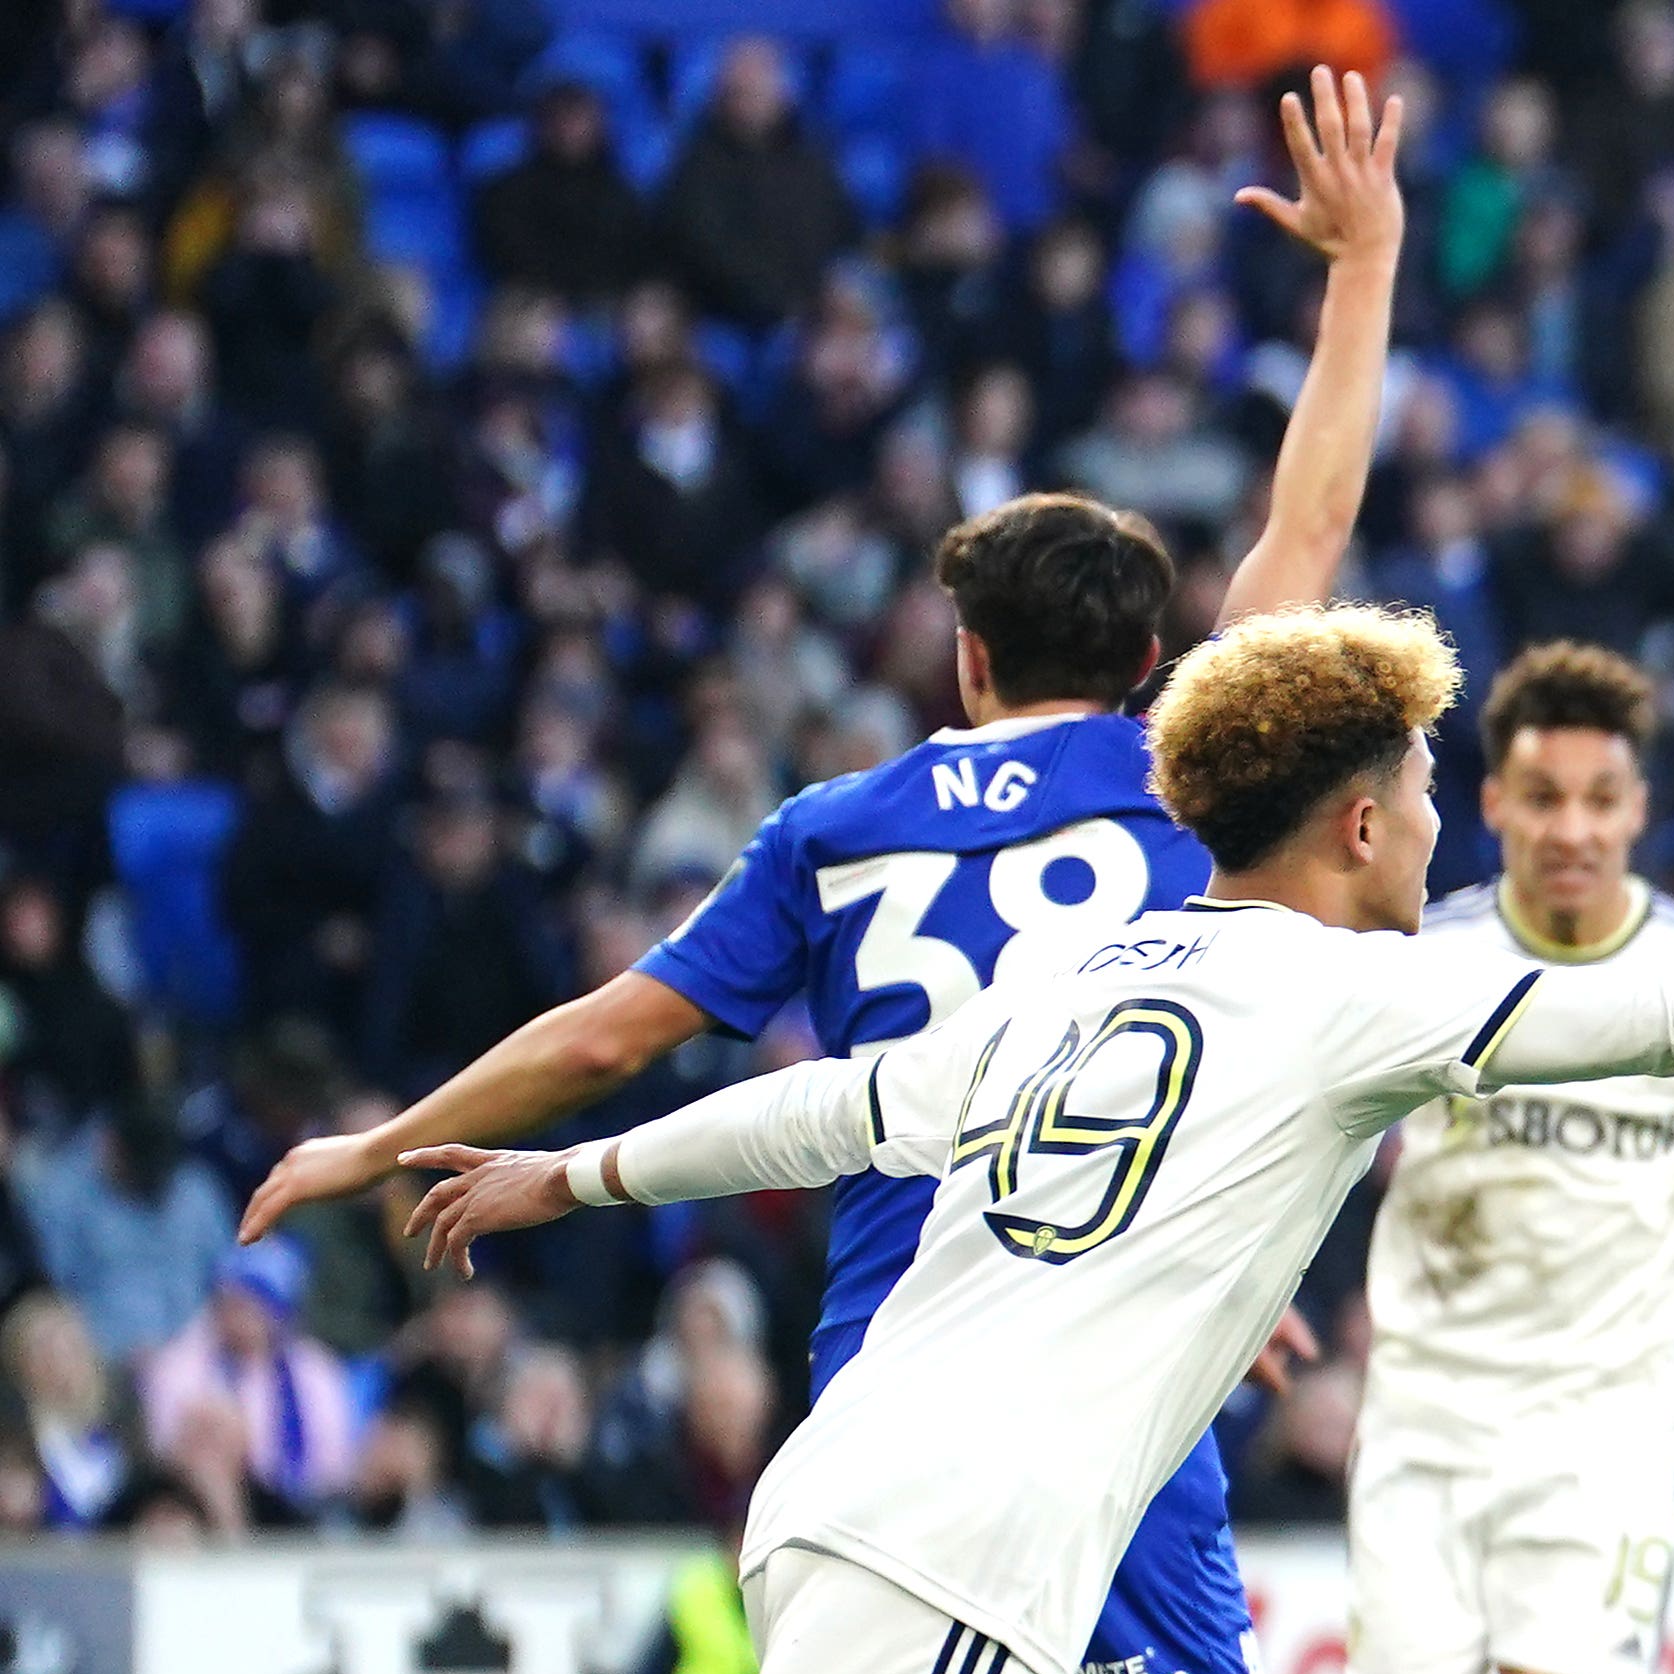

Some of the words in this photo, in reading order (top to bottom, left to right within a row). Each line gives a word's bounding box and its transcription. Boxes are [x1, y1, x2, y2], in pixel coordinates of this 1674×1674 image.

[931, 757, 1038, 812] NG
[816, 817, 1149, 1057] 38
[948, 998, 1204, 1266] 49
